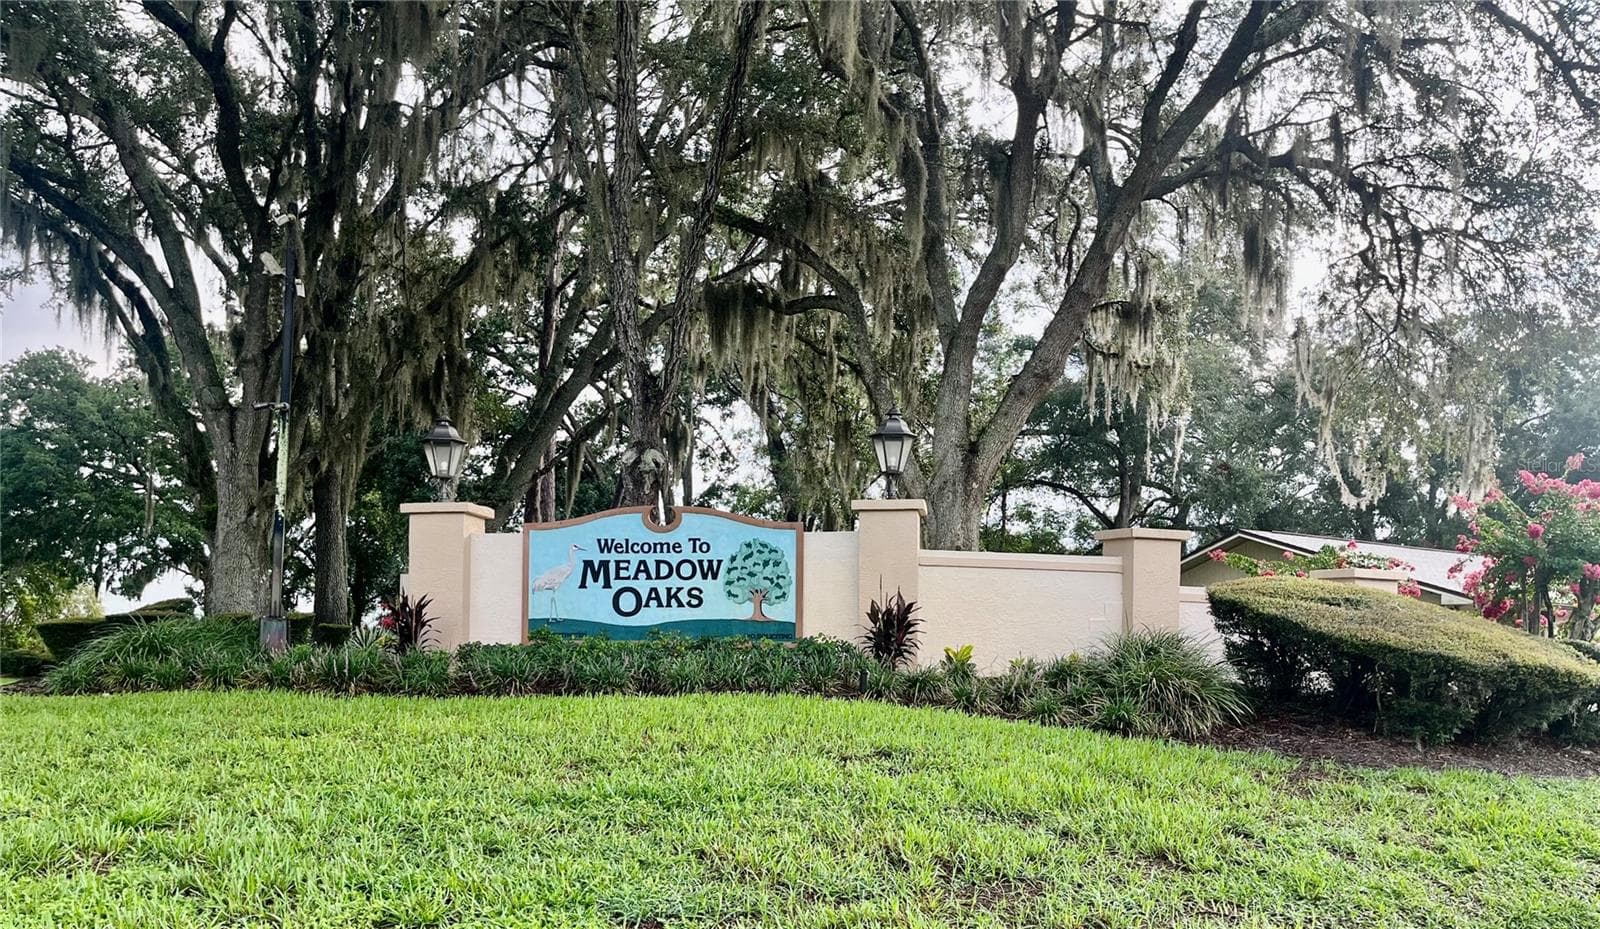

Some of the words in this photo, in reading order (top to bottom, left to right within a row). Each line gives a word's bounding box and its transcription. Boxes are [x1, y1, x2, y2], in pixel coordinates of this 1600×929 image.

[597, 538, 683, 554] Welcome
[688, 538, 711, 554] To
[578, 559, 723, 589] MEADOW
[612, 586, 704, 617] OAKS
